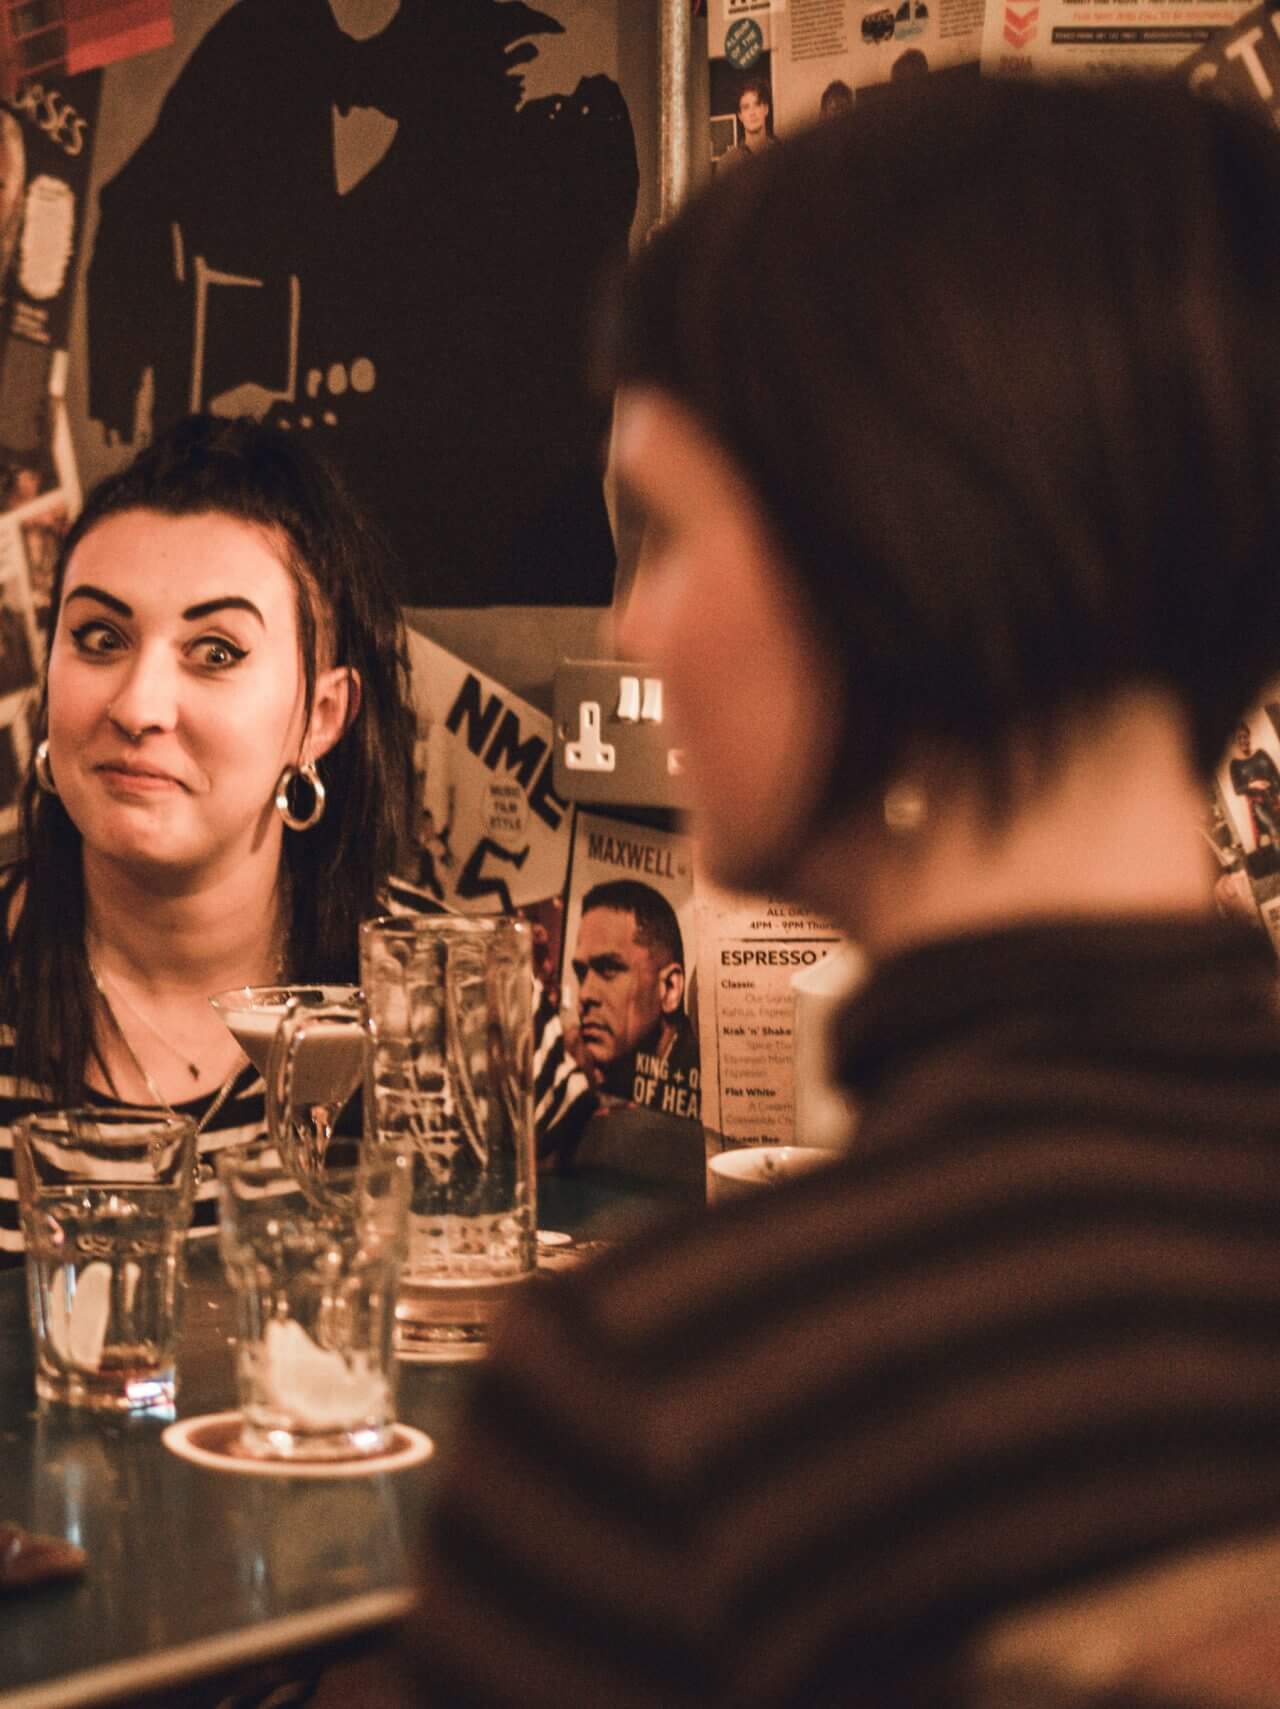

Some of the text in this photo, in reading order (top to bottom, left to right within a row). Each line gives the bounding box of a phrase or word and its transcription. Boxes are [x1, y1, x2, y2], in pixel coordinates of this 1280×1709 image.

[588, 832, 675, 879] MAXWELL
[720, 949, 818, 966] ESPRESSO
[721, 979, 755, 990] Classic
[635, 1052, 669, 1081] KING
[633, 1075, 699, 1119] OF HEA
[725, 1087, 777, 1097] Flat White
